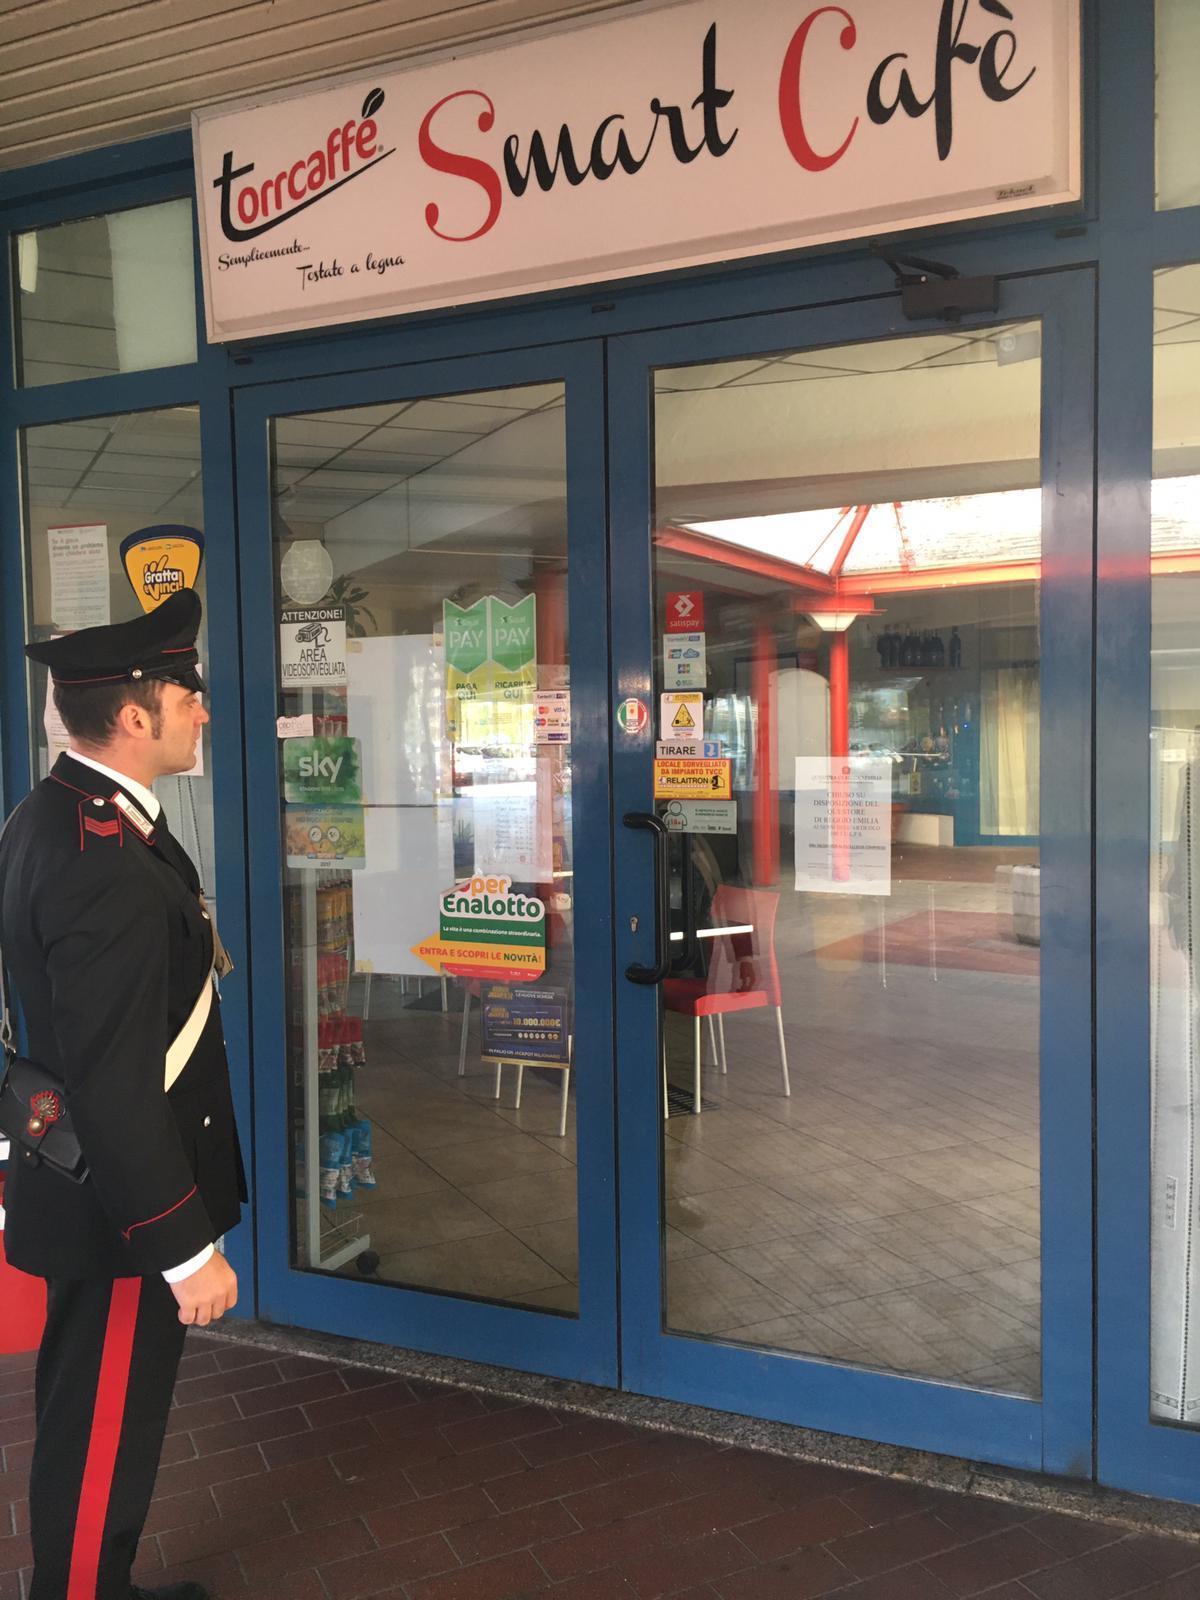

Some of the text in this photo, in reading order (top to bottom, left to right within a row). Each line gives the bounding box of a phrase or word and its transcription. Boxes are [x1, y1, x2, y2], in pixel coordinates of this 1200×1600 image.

[418, 0, 1037, 242] Smart Cafè
[296, 252, 405, 290] Tostato a legna
[144, 571, 179, 584] Gratta
[281, 609, 343, 622] ATTENZIONE!
[670, 619, 700, 628] satispay
[449, 630, 484, 648] PAY
[495, 627, 531, 647] PAY
[300, 648, 327, 662] AREA
[282, 662, 346, 677] VIDEOSORVEGLIATA
[456, 682, 478, 690] PAGA
[457, 690, 476, 701] QUI
[503, 690, 523, 699] QUI
[660, 746, 696, 755] TIRARE
[298, 750, 344, 783] sky
[443, 894, 541, 918] Enalotto
[419, 947, 448, 956] ENTRA
[450, 949, 455, 957] E
[457, 950, 489, 959] SCOPRI
[491, 952, 501, 960] LE
